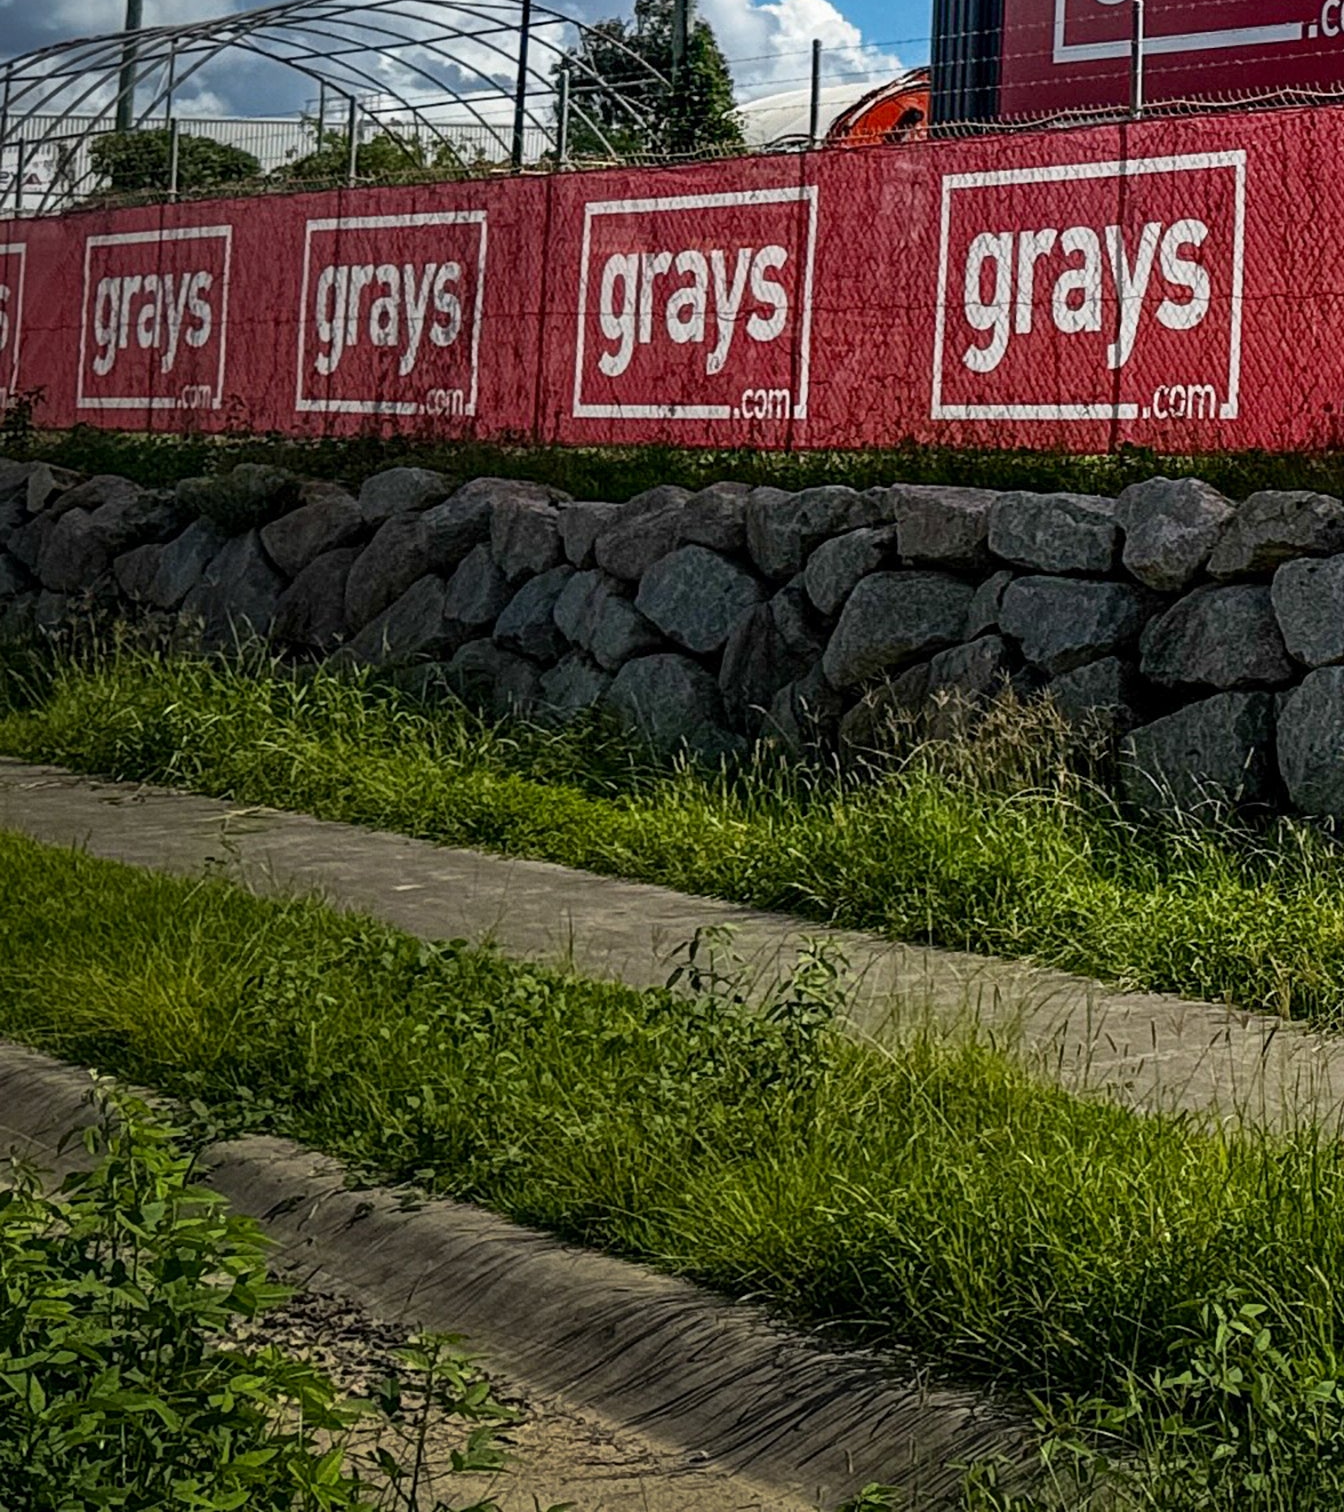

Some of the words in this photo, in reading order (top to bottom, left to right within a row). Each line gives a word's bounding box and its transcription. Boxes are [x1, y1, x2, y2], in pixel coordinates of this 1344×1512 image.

[93, 271, 213, 376] grays
[315, 261, 462, 376] grays
[597, 244, 788, 377] grays
[962, 218, 1210, 372] grays
[733, 388, 791, 419] .com
[1142, 384, 1217, 420] .com
